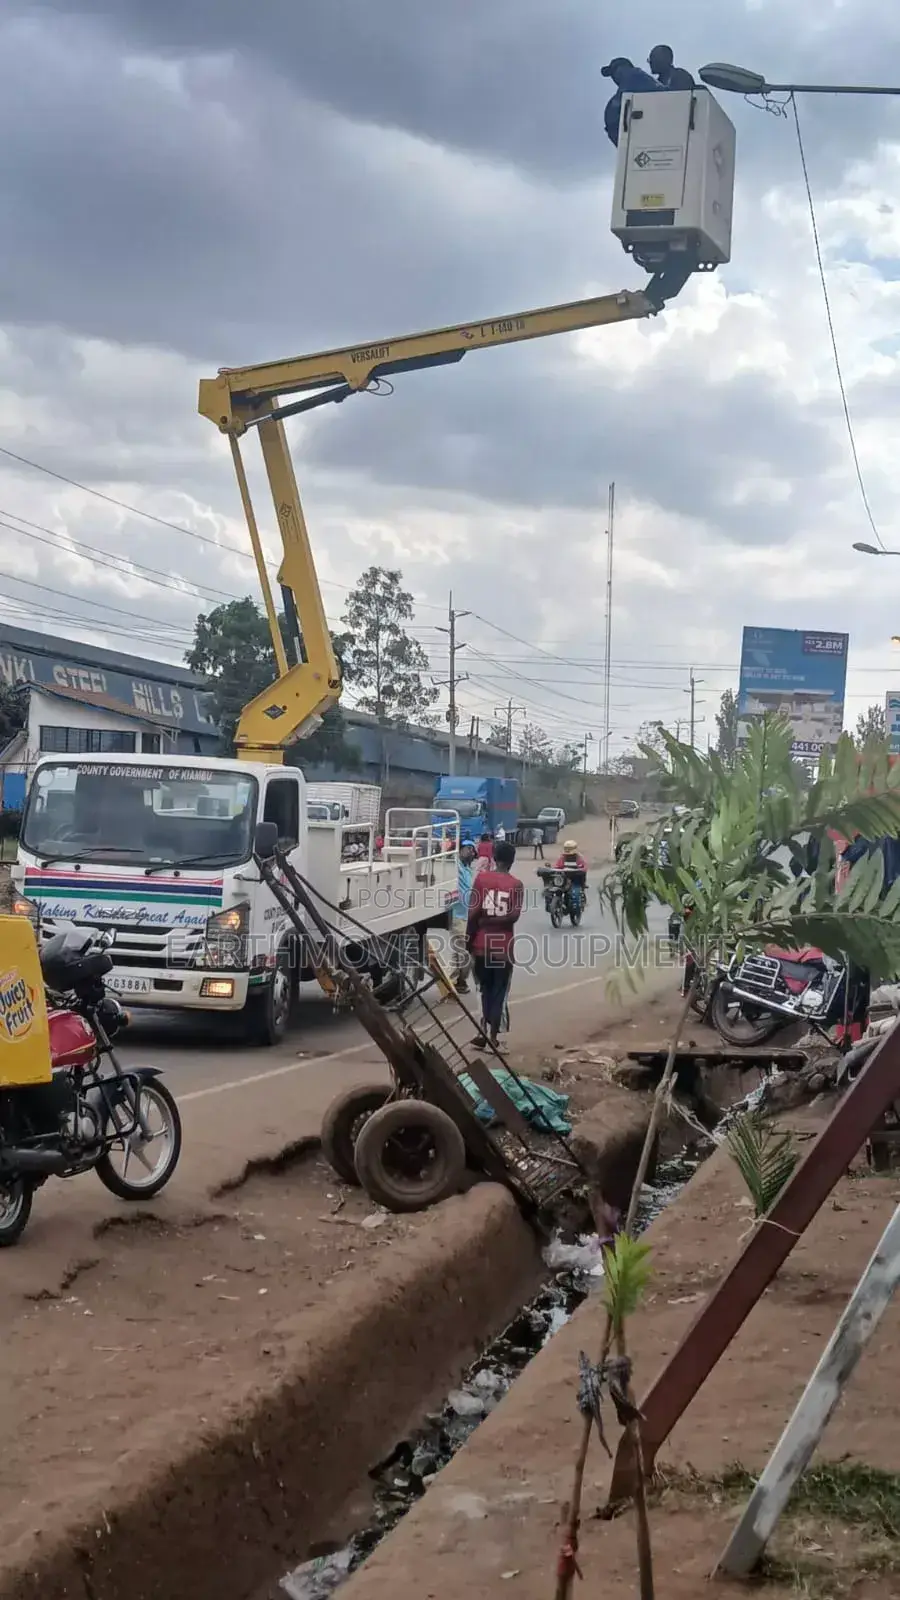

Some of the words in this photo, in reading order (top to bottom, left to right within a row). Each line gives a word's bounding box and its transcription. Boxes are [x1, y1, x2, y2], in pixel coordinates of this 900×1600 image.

[351, 346, 389, 363] VERSALIFT
[815, 641, 843, 650] 2.8M
[132, 681, 184, 718] MILLS
[76, 764, 109, 776] COUNTY
[109, 766, 163, 780] GOVERNMENT
[168, 769, 179, 780] OF
[180, 770, 213, 781] KIAMBU
[482, 889, 509, 916] 45
